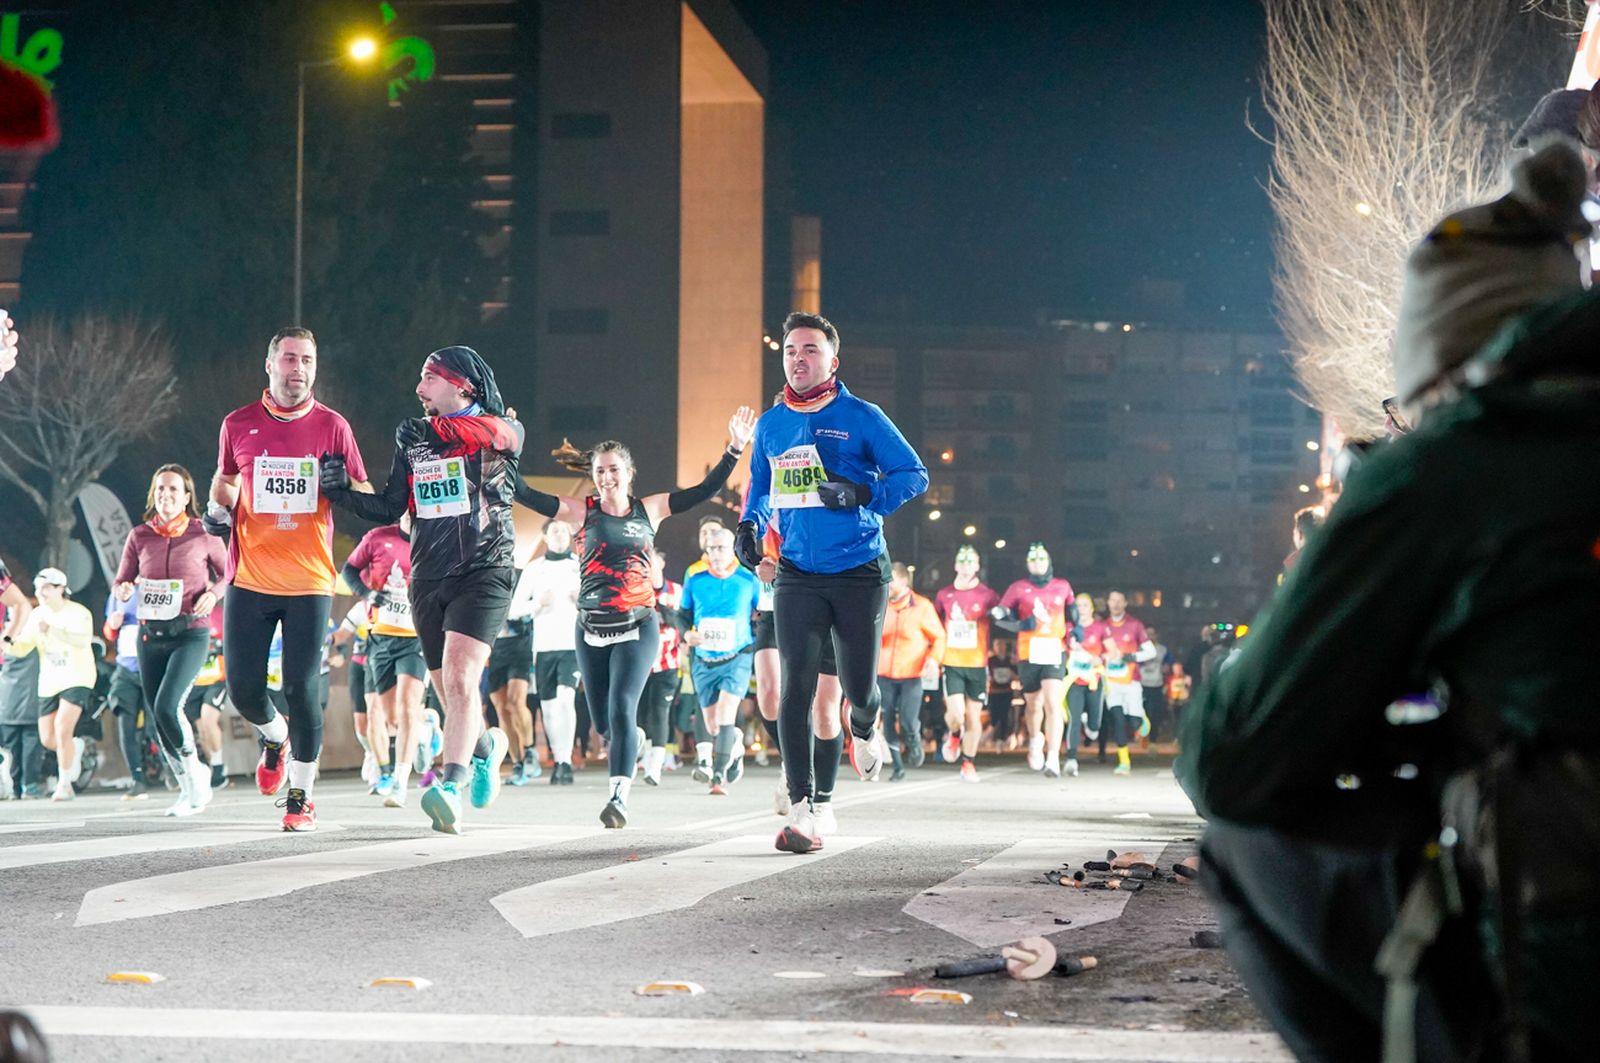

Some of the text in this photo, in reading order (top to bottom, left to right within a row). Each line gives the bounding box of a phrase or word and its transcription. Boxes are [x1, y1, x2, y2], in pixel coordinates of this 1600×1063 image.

[265, 477, 306, 495] 4358
[783, 467, 822, 487] 4689
[418, 479, 459, 499] 12618
[144, 592, 173, 606] 6399
